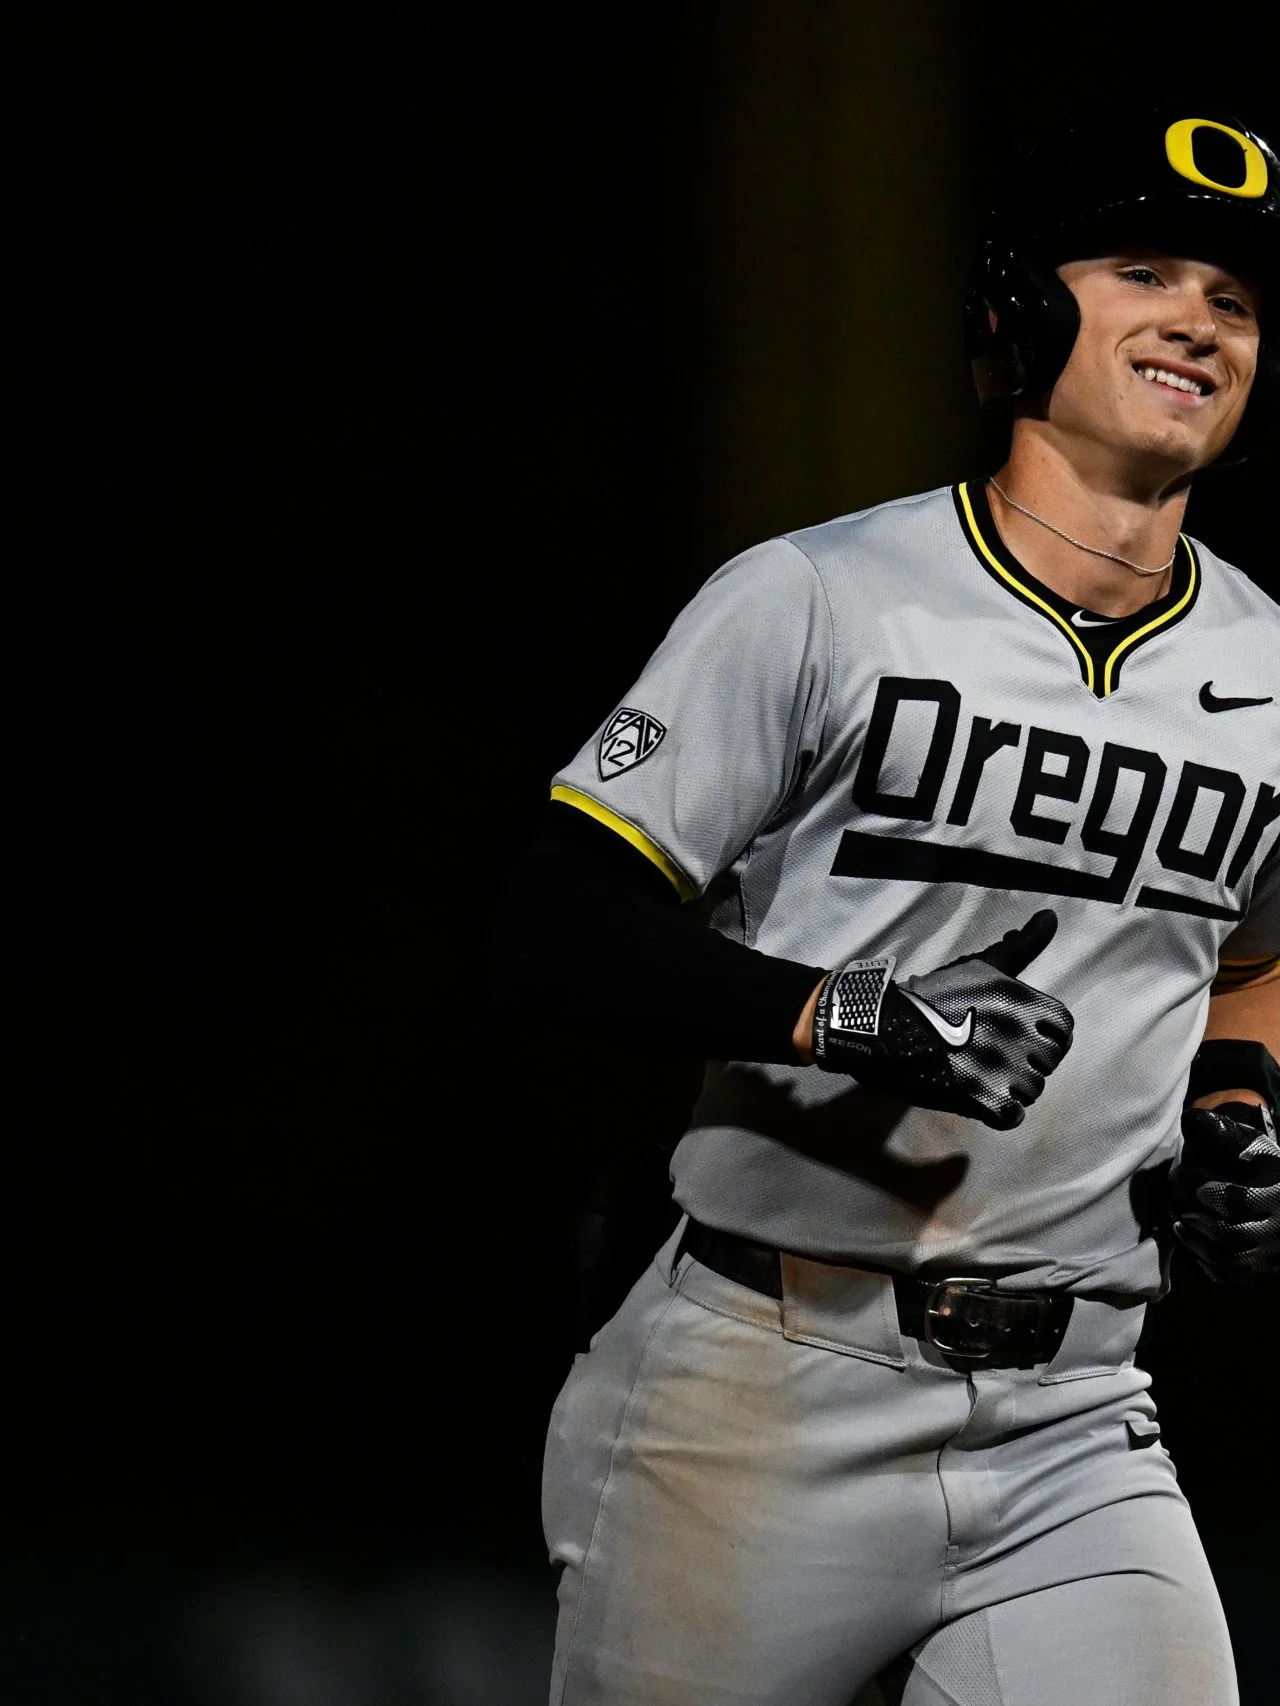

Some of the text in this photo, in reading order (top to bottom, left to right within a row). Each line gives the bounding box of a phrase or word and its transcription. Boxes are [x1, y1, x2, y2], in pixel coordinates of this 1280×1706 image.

[1165, 118, 1268, 198] O
[603, 710, 664, 760] PAC
[602, 738, 636, 767] 12
[816, 1016, 827, 1027] of
[816, 1029, 826, 1058] Heart
[828, 1037, 872, 1055] REGON
